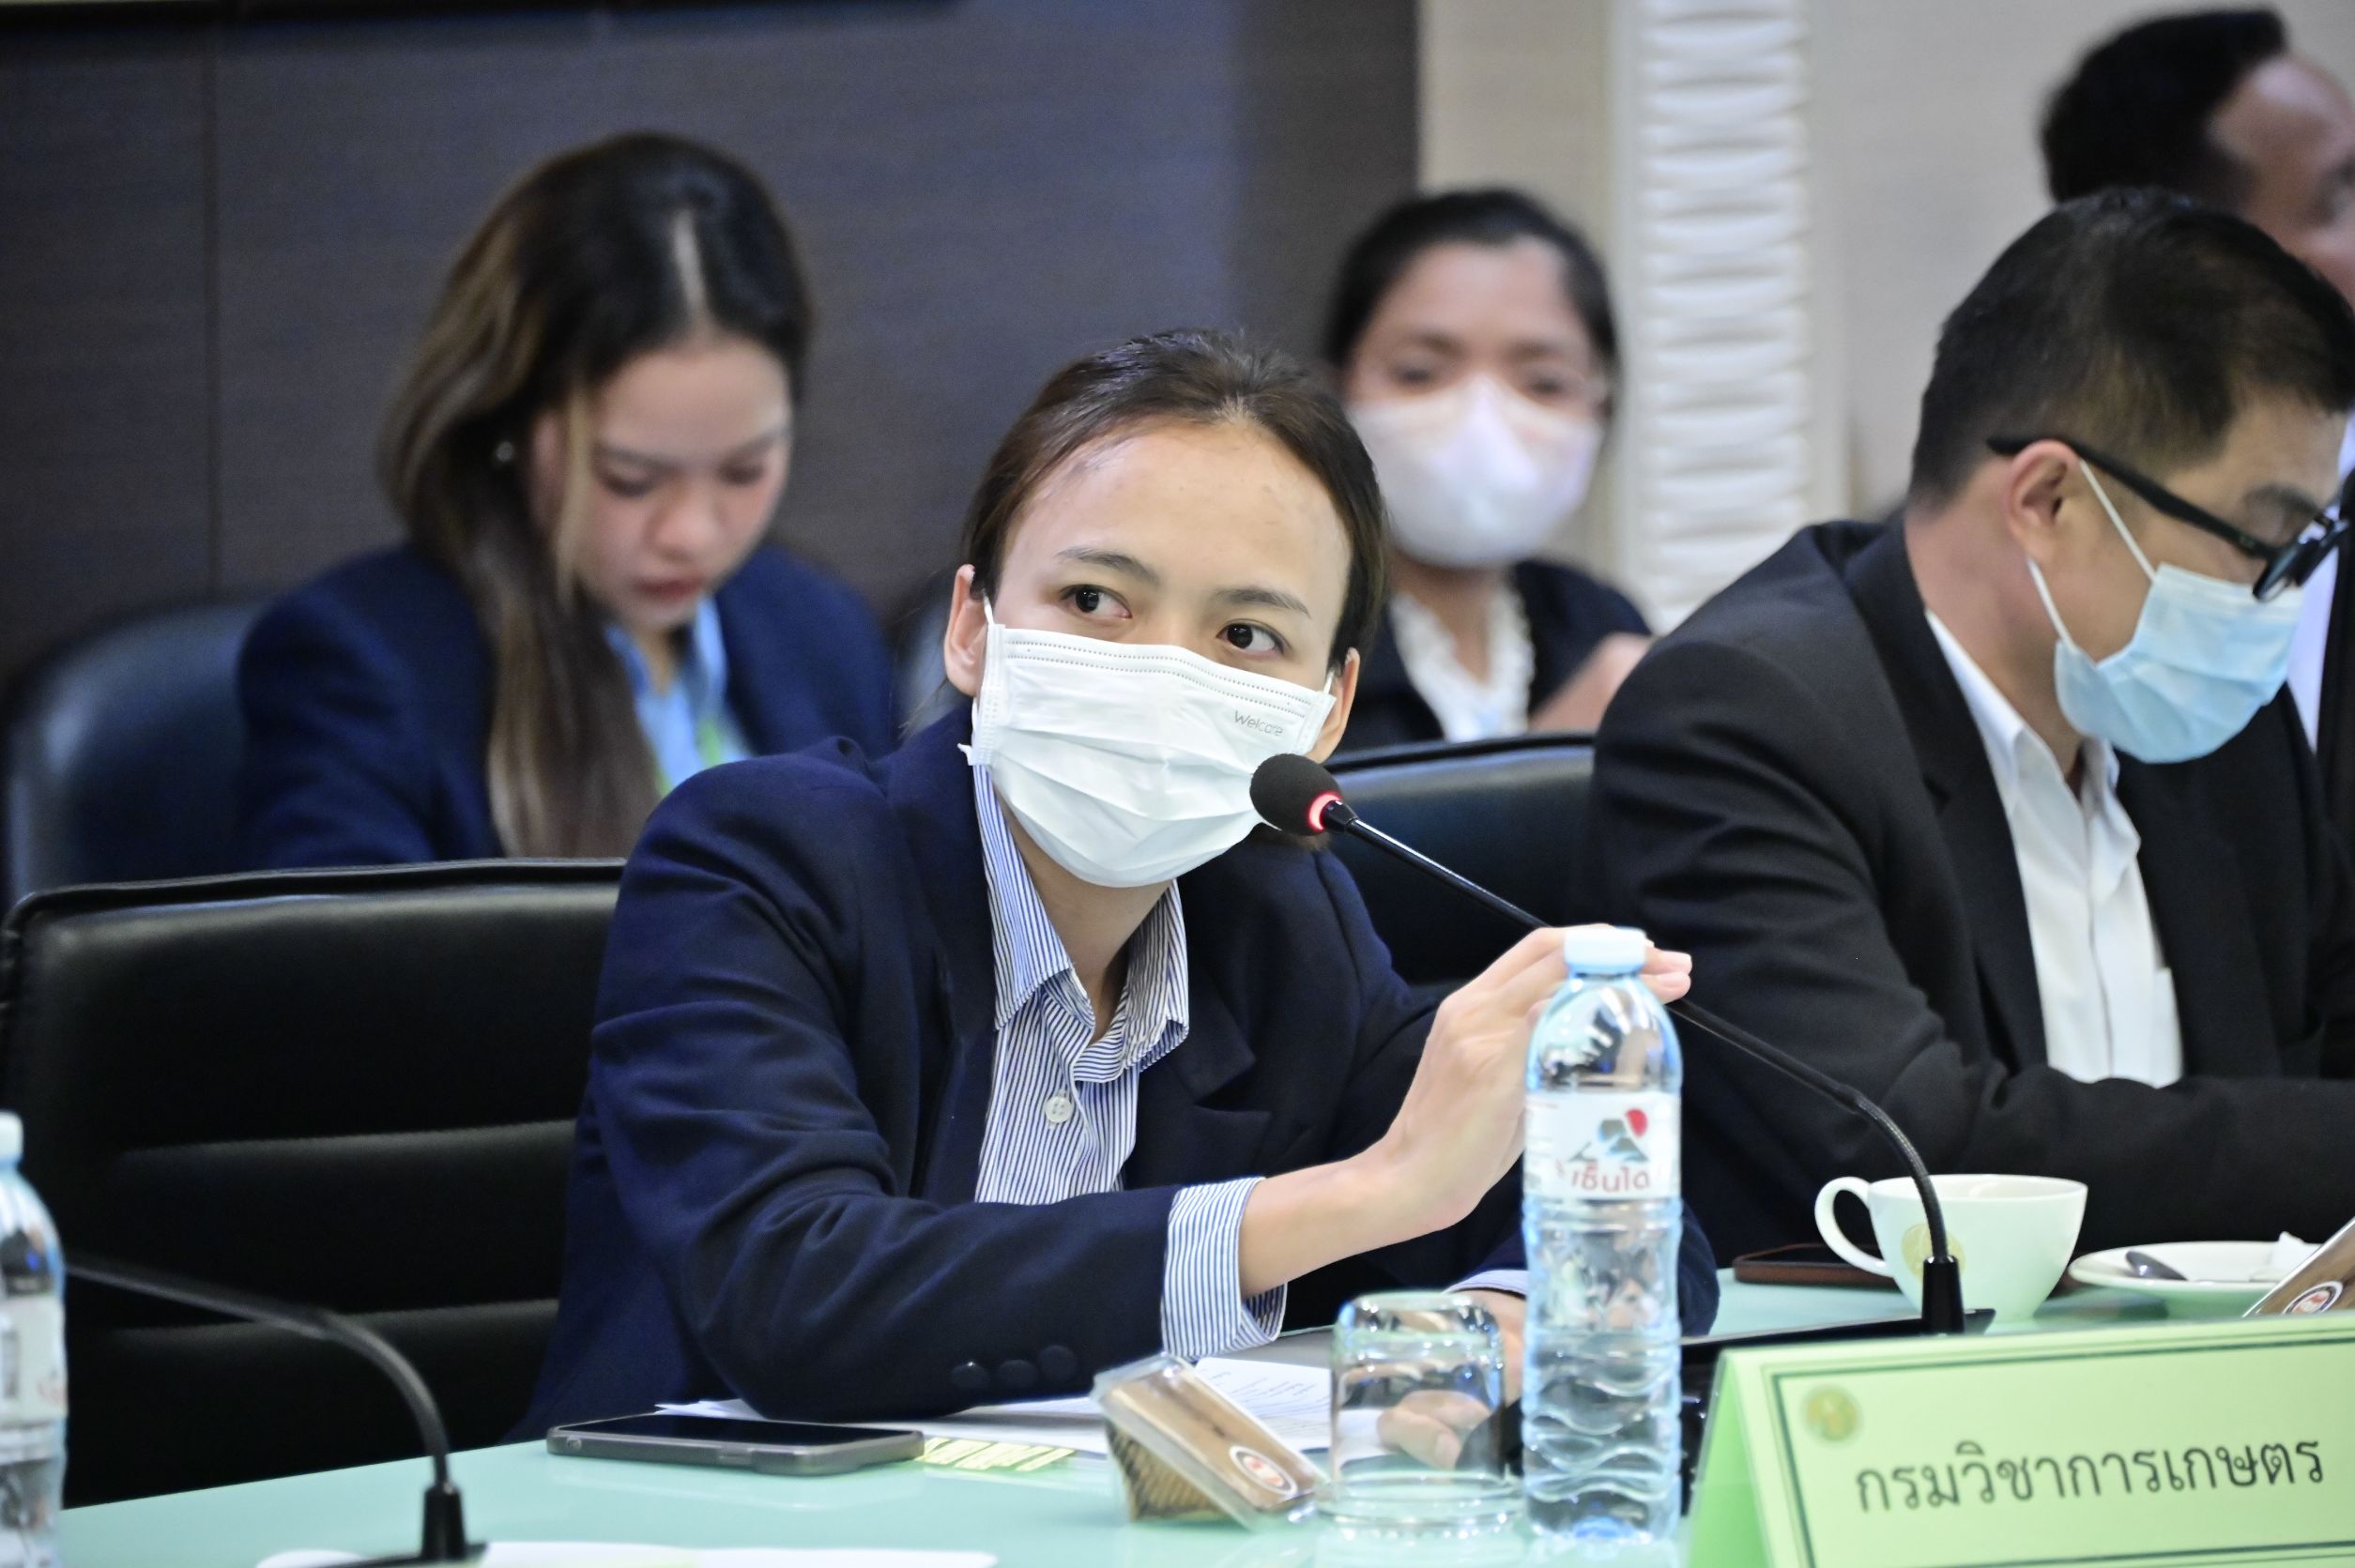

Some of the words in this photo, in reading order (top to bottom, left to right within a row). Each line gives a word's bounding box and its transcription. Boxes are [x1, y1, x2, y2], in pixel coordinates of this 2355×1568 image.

[1856, 1439, 2324, 1513] กรมวิชาการเกษตร
